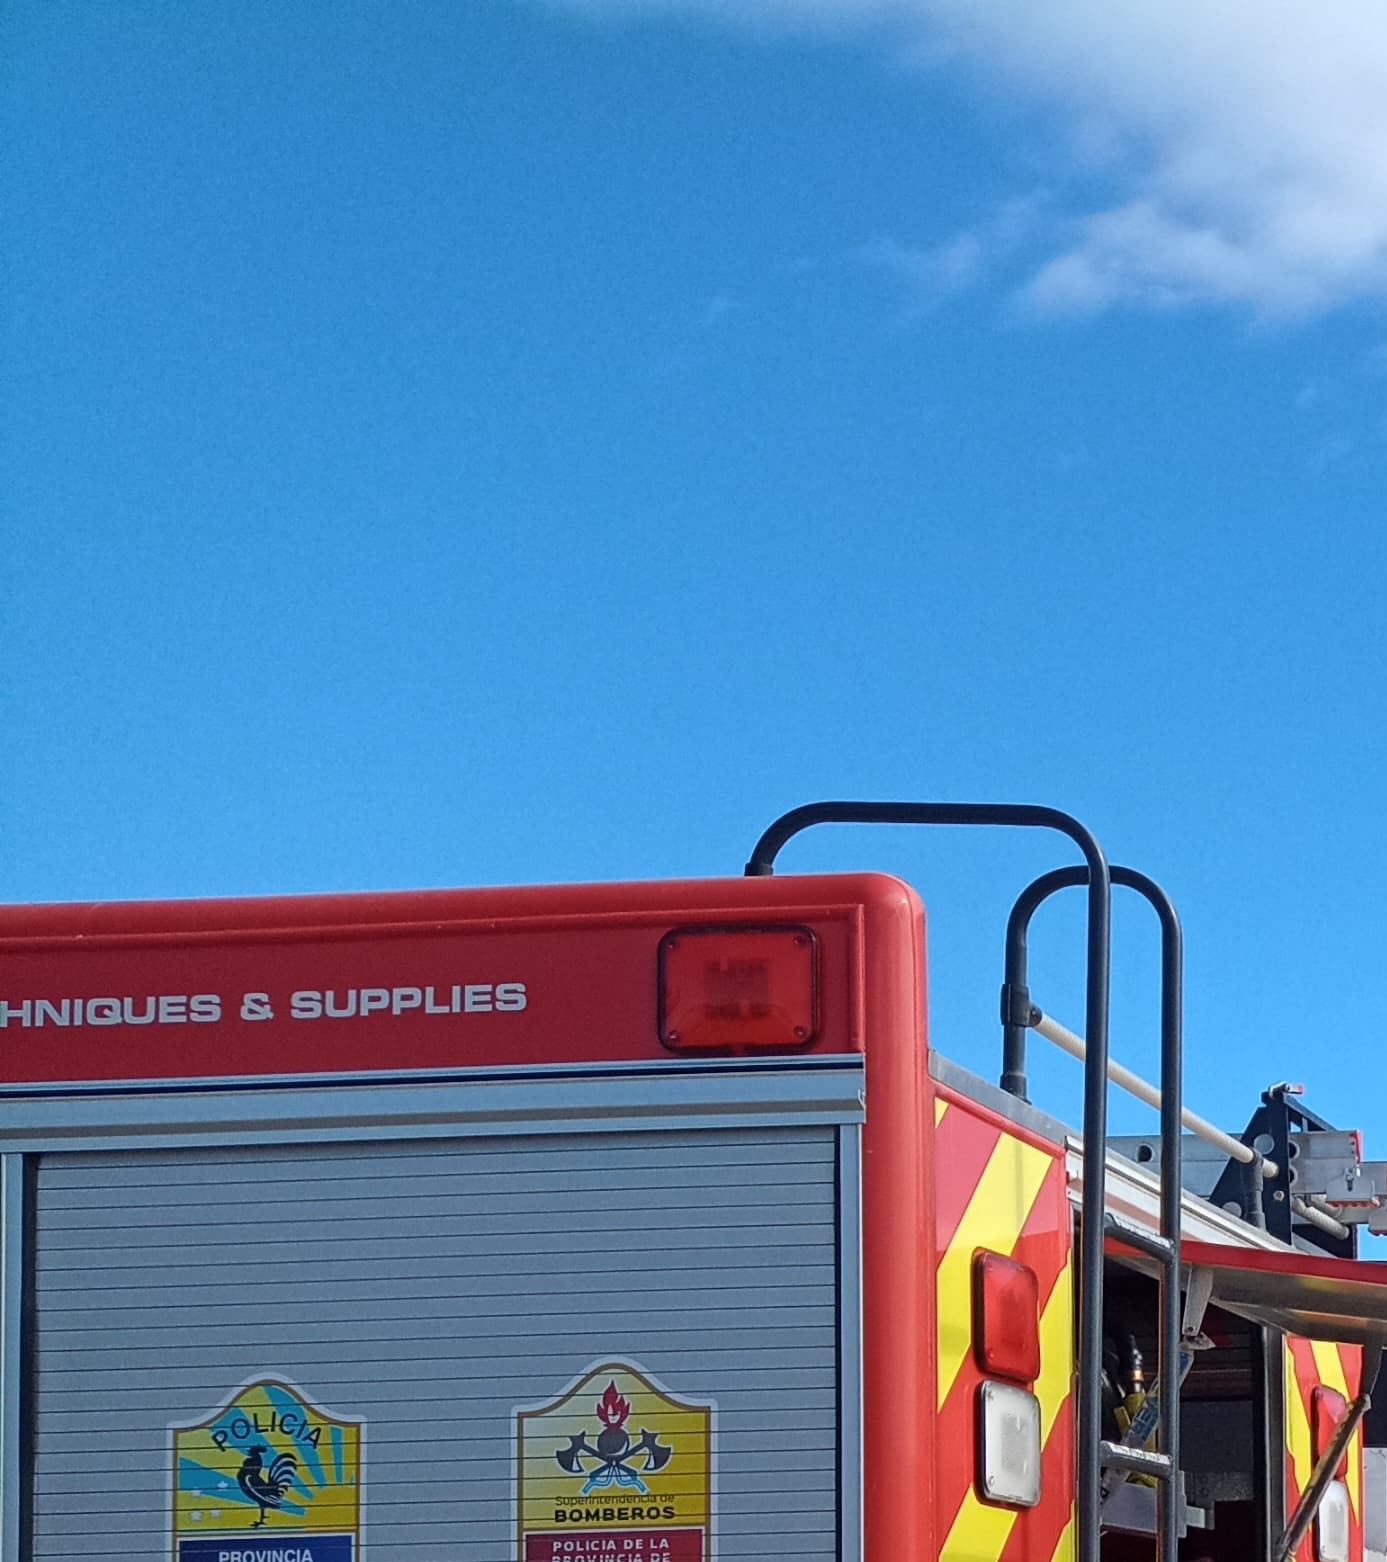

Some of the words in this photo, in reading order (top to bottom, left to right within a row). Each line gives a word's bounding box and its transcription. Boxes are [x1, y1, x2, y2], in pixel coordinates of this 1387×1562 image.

[0, 994, 222, 1028] HNIQUES
[240, 992, 274, 1021] &
[290, 983, 527, 1019] SUPPLIES
[211, 1411, 322, 1452] POLICIA
[554, 1494, 657, 1508] Superintendencia
[660, 1493, 676, 1503] de
[554, 1506, 676, 1523] BOMBEROS
[552, 1540, 617, 1553] POLICIA
[623, 1538, 644, 1550] DE
[650, 1538, 670, 1549] LA
